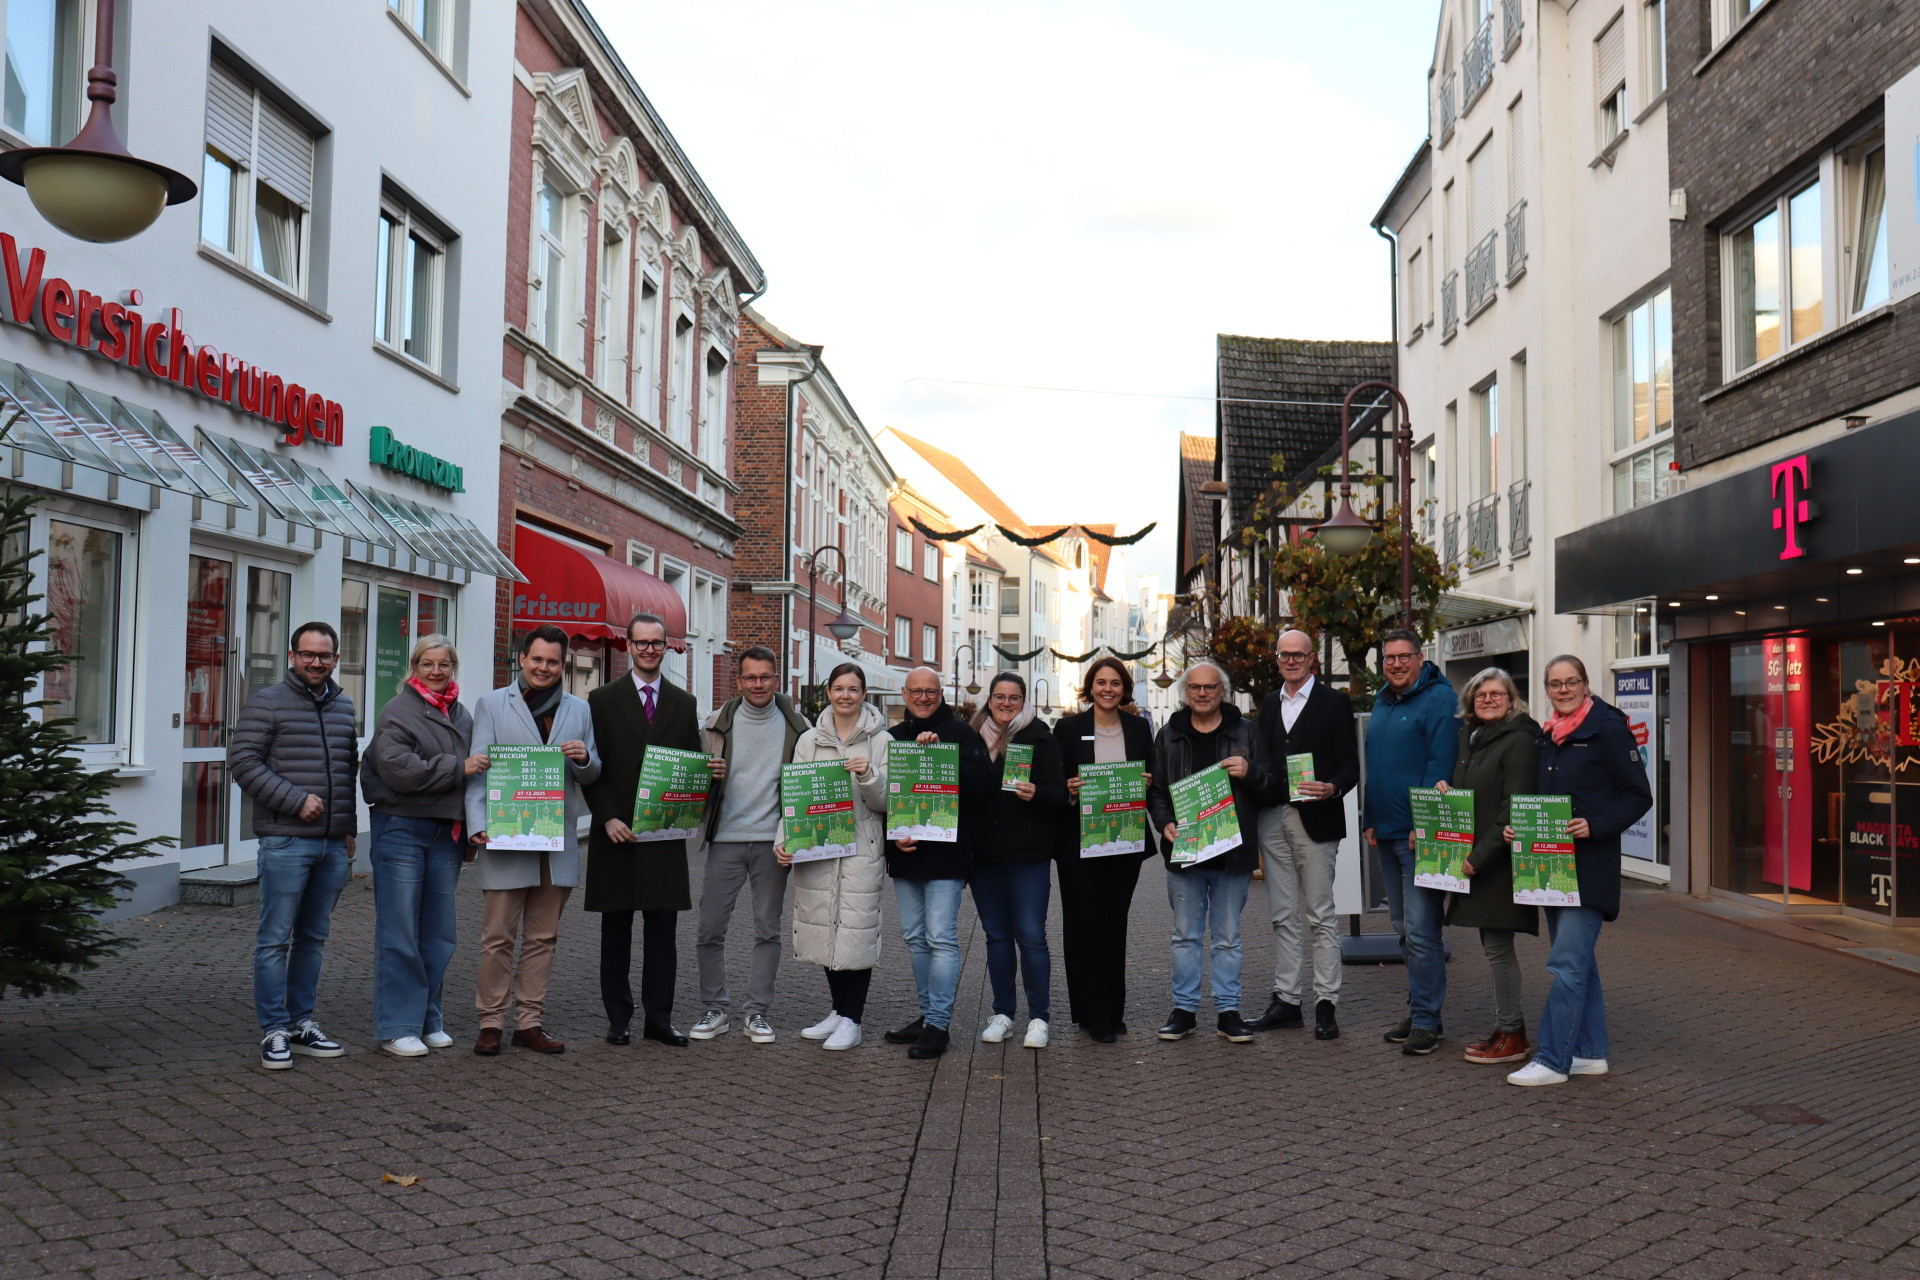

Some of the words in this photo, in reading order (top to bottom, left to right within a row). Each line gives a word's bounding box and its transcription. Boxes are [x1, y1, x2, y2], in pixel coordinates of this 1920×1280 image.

[0, 232, 343, 447] Versicherungen
[369, 426, 465, 493] PROVINZIAL
[1772, 455, 1807, 560] T
[514, 594, 600, 617] Friseur
[1452, 633, 1470, 652] SPORT
[1471, 631, 1484, 649] HILL
[1618, 678, 1636, 691] SPORT
[1637, 678, 1650, 690] HILL
[1768, 681, 1800, 691] Deutsclands
[655, 754, 679, 763] BECKUM
[1170, 763, 1221, 790] WEIHNACHTSMÄRKT
[1850, 831, 1883, 846] BLACK
